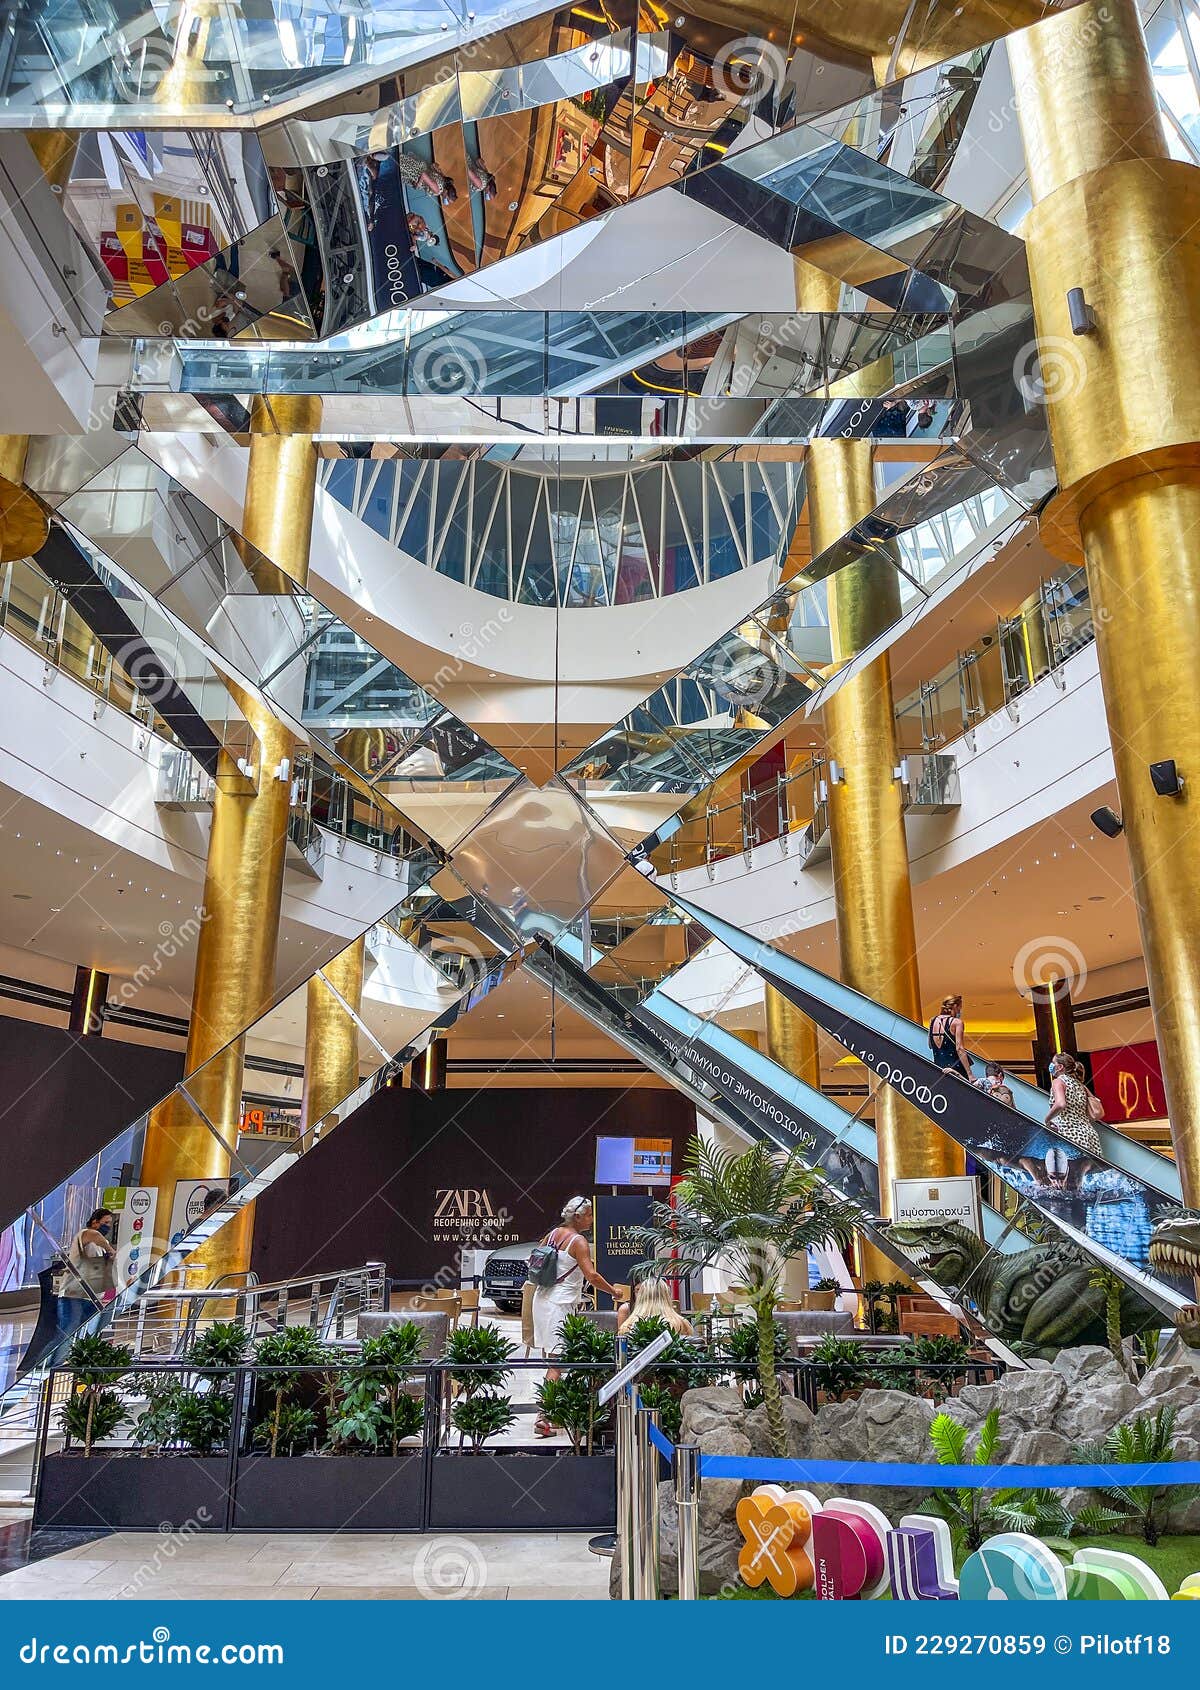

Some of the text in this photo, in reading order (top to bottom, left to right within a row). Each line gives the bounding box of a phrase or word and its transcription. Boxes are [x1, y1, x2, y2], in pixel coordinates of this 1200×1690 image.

[434, 1188, 496, 1217] ZARA
[434, 1218, 506, 1228] REOPENING SOON
[433, 1233, 520, 1242] www.zara.com
